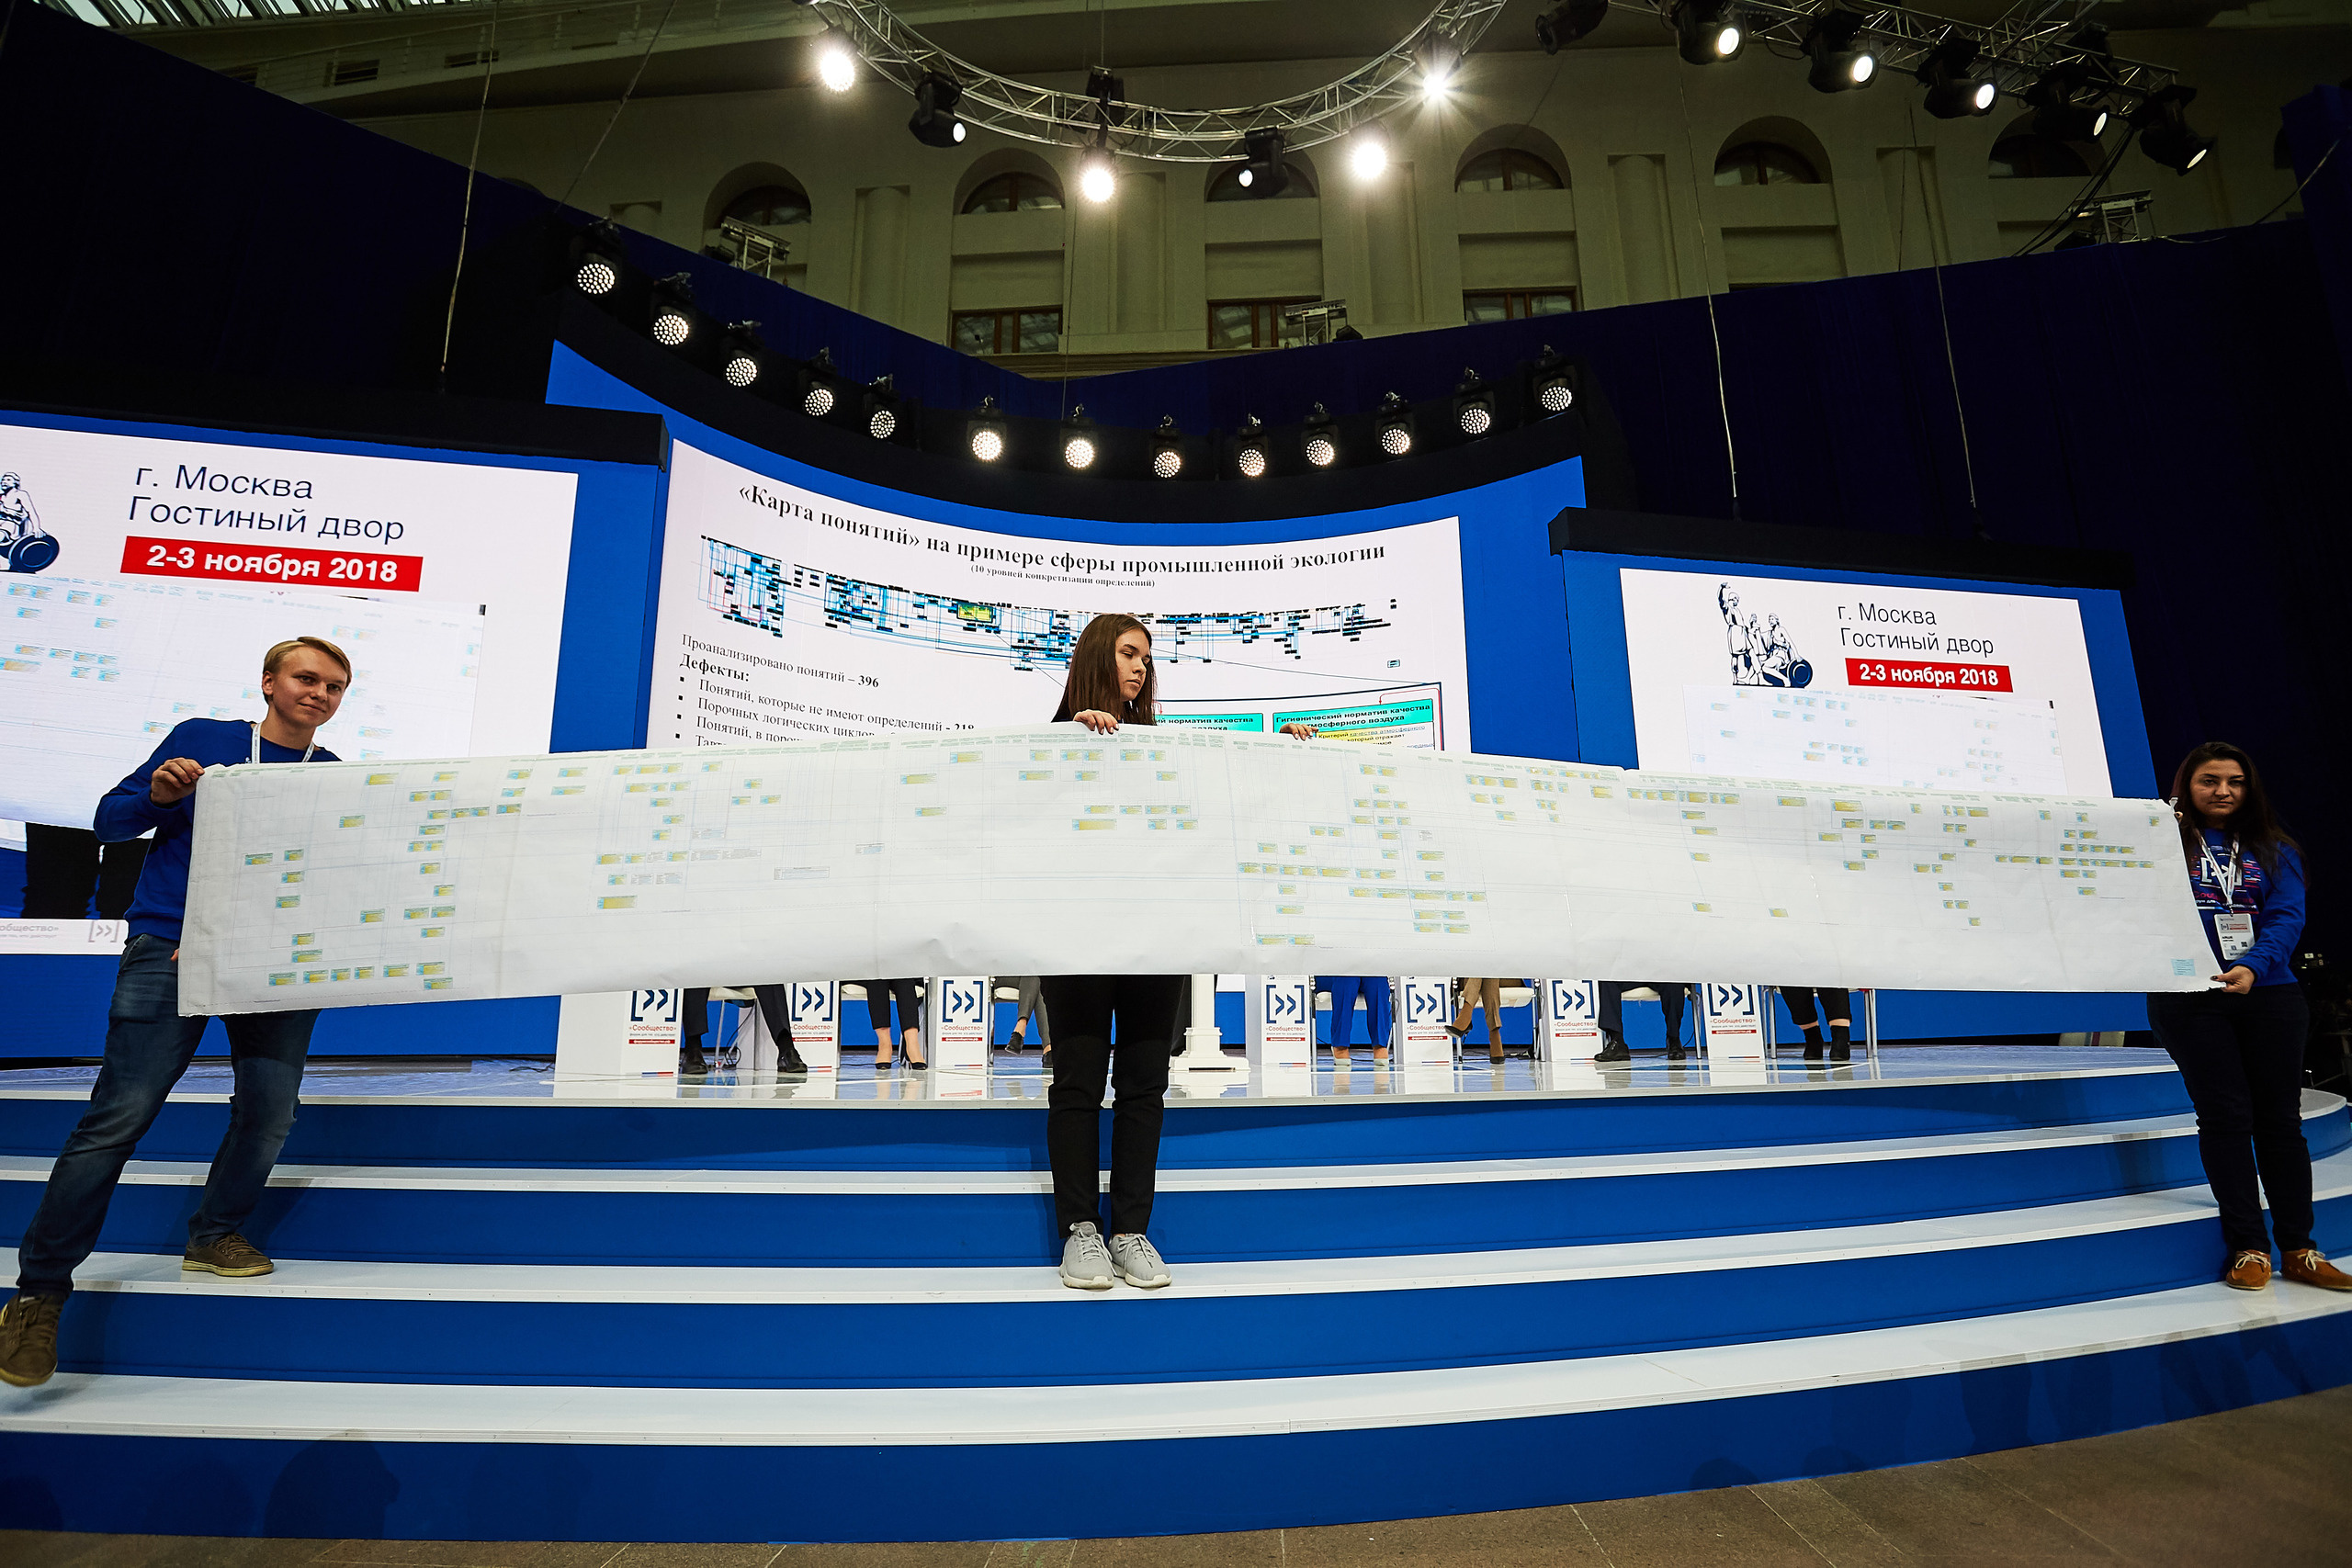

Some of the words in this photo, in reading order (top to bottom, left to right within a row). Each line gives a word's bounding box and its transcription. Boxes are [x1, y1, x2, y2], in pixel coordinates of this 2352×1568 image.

[136, 468, 158, 487] г.
[175, 465, 312, 499] Москва
[130, 495, 306, 533] Гостиный
[318, 516, 404, 545] двор
[739, 484, 814, 521] «Карта
[821, 513, 920, 547] понятий»
[927, 536, 950, 553] на
[957, 543, 1044, 569] примере
[1050, 552, 1114, 574] сферы
[1123, 555, 1283, 577] промышленной
[1290, 546, 1385, 569] экологии
[146, 545, 196, 569] 2-3
[204, 553, 320, 581] ноября
[328, 558, 398, 582] 2018
[971, 565, 985, 574] (10
[987, 567, 1023, 579] уровней
[1025, 572, 1093, 584] конкретизации
[1095, 577, 1155, 588] определений)
[1838, 606, 1851, 620] г.
[1859, 603, 1937, 625] Москва
[1840, 627, 1939, 650] Гостиный
[1946, 637, 1994, 658] двор
[679, 653, 750, 682] Дефекты:
[682, 634, 793, 671] Проанализировано
[797, 665, 844, 682] понятий
[858, 675, 879, 688] 396
[1859, 663, 1886, 681] 2-3
[1891, 667, 1956, 687] ноября
[1959, 668, 1998, 685] 2018
[698, 697, 759, 721] Порочных
[762, 714, 830, 733] логических
[699, 679, 754, 704] Понятий,
[758, 695, 805, 712] которые
[809, 705, 822, 716] не
[826, 708, 864, 722] имеют
[867, 715, 942, 731] определений
[1276, 713, 1342, 723] Гигиенический
[1344, 709, 1387, 719] норматив
[1390, 705, 1430, 714] качества
[696, 716, 752, 739] Понятий,
[756, 731, 762, 739] в
[1306, 719, 1366, 728] тмосферного
[1368, 715, 1405, 725] воздуха
